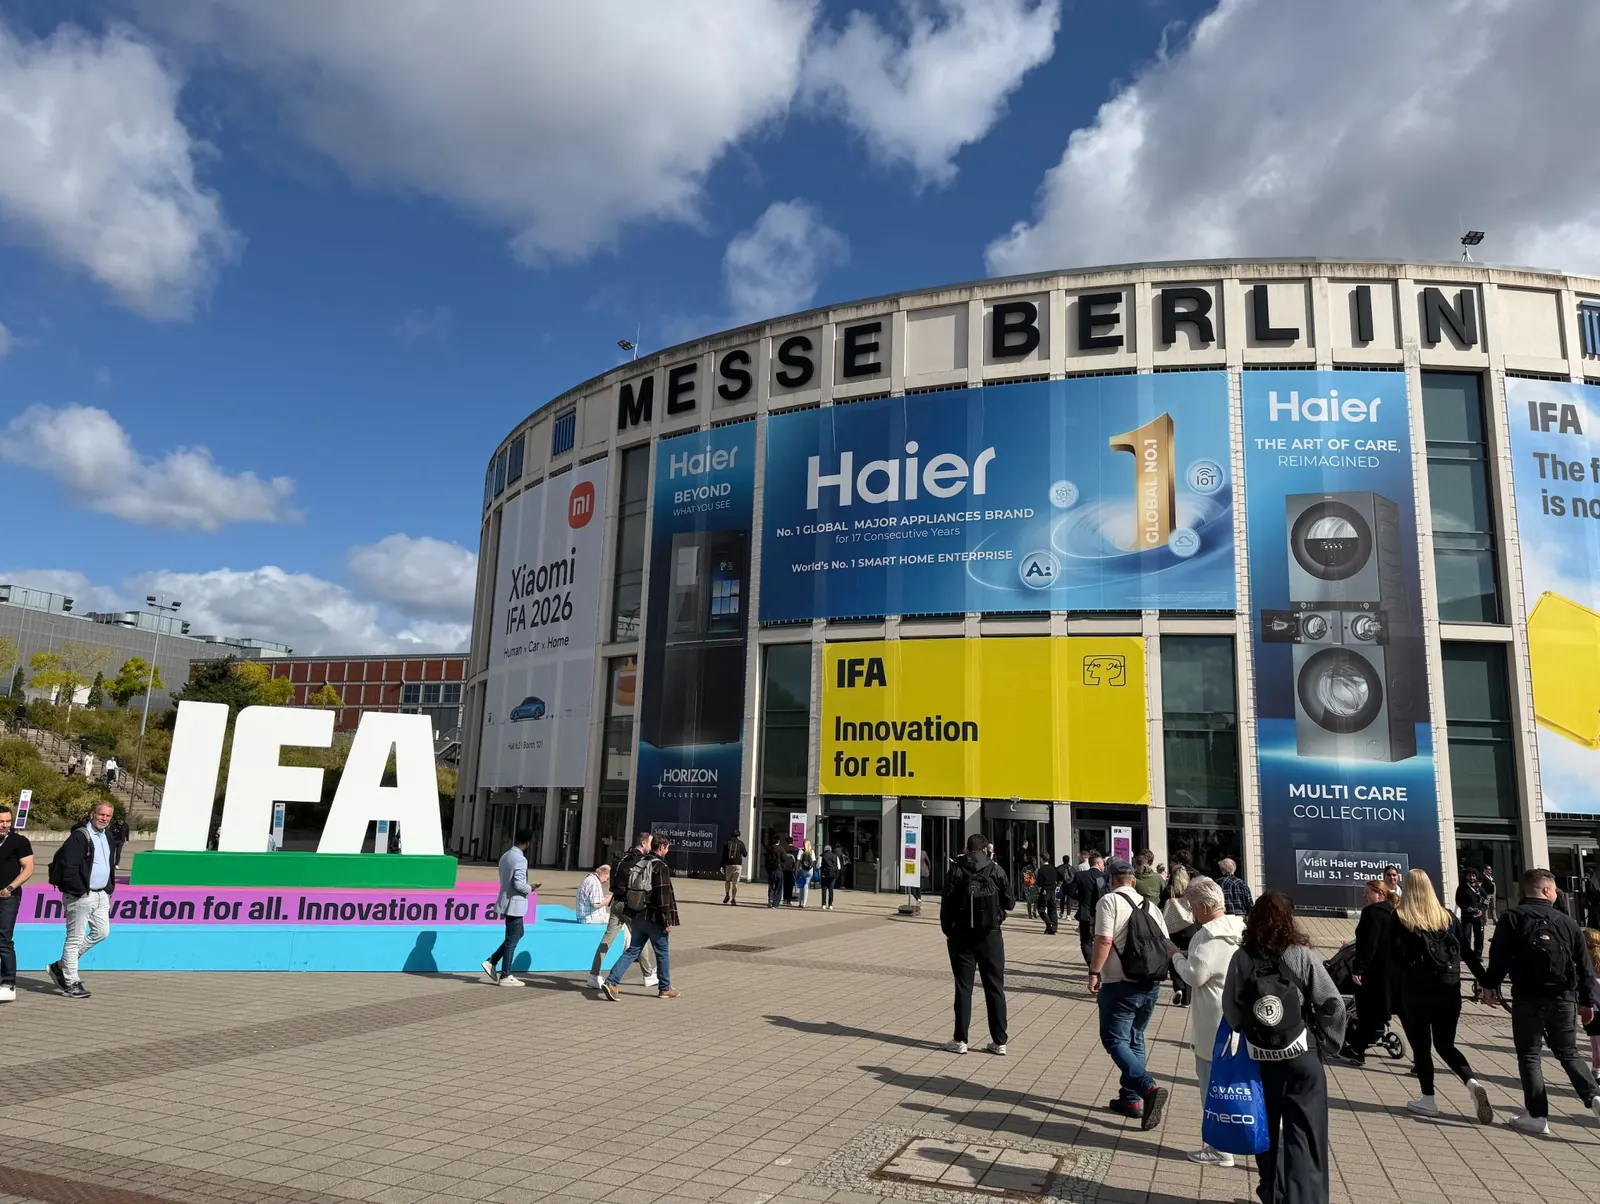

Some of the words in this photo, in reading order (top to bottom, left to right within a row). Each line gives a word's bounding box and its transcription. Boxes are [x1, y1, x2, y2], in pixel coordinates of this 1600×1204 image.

[617, 321, 882, 430] MESSE
[992, 285, 1478, 358] BERLIN
[1268, 389, 1381, 422] Haier
[1528, 400, 1583, 436] IFA
[1144, 438, 1158, 473] NO.1
[1254, 438, 1287, 450] THE
[1291, 438, 1323, 450] ART
[1327, 438, 1350, 450] OF
[1354, 439, 1401, 453] CARE,
[669, 444, 738, 480] Haier
[1278, 455, 1380, 468] REIMAGINED
[1532, 451, 1585, 483] The
[806, 440, 996, 510] Haier
[1196, 475, 1217, 486] IoT
[674, 483, 731, 504] BEYOND
[1541, 488, 1566, 517] is
[672, 505, 696, 517] WHAT
[696, 503, 714, 513] YOU
[715, 499, 731, 509] SEE
[1145, 480, 1160, 544] GLOBAL
[776, 528, 794, 538] No.
[796, 526, 800, 536] 1
[803, 521, 848, 534] GLOBAL
[854, 517, 897, 530] MAJOR
[900, 510, 982, 526] APPLIANCES
[985, 508, 1034, 521] BRAND
[835, 534, 850, 544] for
[852, 533, 862, 542] 17
[864, 528, 928, 542] Consecutive
[931, 526, 961, 538] Years
[509, 546, 577, 603] Xiaomi
[792, 561, 829, 573] World's
[832, 560, 848, 570] No.
[851, 560, 856, 568] 1
[858, 556, 896, 568] SMART
[900, 554, 935, 565] HOME
[938, 550, 1013, 564] ENTERPRISE
[506, 604, 526, 636] IFA
[530, 592, 573, 628] 2026
[504, 645, 523, 659] Human
[528, 640, 540, 654] Car
[547, 635, 570, 650] Home
[836, 656, 888, 688] IFA
[835, 714, 979, 742] Innovation
[663, 768, 718, 783] HORIZON
[833, 750, 870, 777] for
[875, 750, 914, 778] all.
[153, 700, 445, 855] IFA
[1288, 783, 1349, 800] MULTI
[1354, 785, 1408, 802] CARE
[1293, 804, 1405, 822] COLLECTION
[669, 829, 686, 838] Haier
[688, 830, 713, 838] Pavilion
[682, 840, 700, 848] Stand
[703, 840, 713, 848] 101
[1303, 858, 1328, 868] Visit
[1330, 858, 1358, 868] Haier
[1304, 870, 1325, 879] Hall
[1328, 871, 1342, 880] 3.1
[1353, 872, 1384, 881] Stand
[34, 892, 196, 920] Invation
[203, 896, 242, 920] for
[248, 896, 288, 920] all.
[298, 896, 438, 921] Innovation
[444, 898, 479, 921] for
[1264, 1004, 1274, 1016] B
[1214, 1094, 1252, 1102] ROBOTICS
